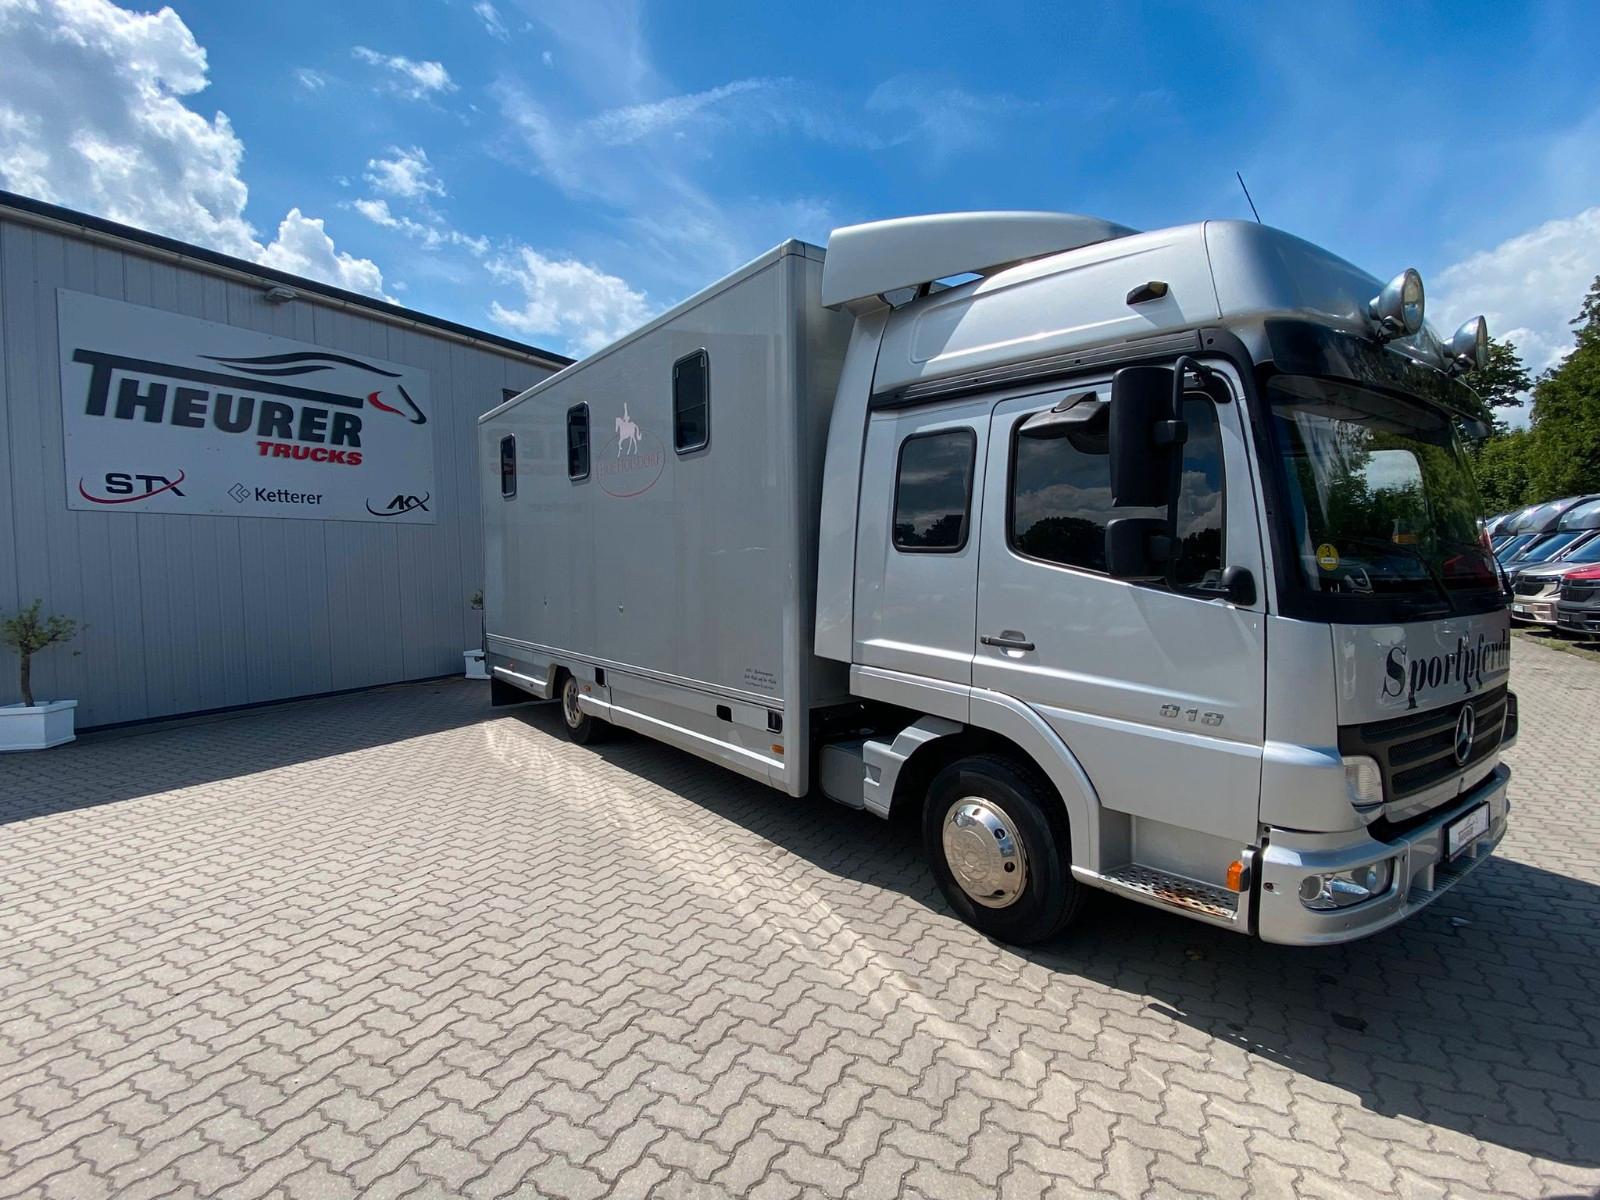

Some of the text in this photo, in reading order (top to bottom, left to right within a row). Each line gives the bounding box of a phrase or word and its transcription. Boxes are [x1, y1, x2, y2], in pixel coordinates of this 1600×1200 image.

[72, 348, 364, 448] THEURER
[256, 440, 363, 466] TRUCKS
[104, 471, 186, 498] STX
[254, 487, 323, 505] Ketterer
